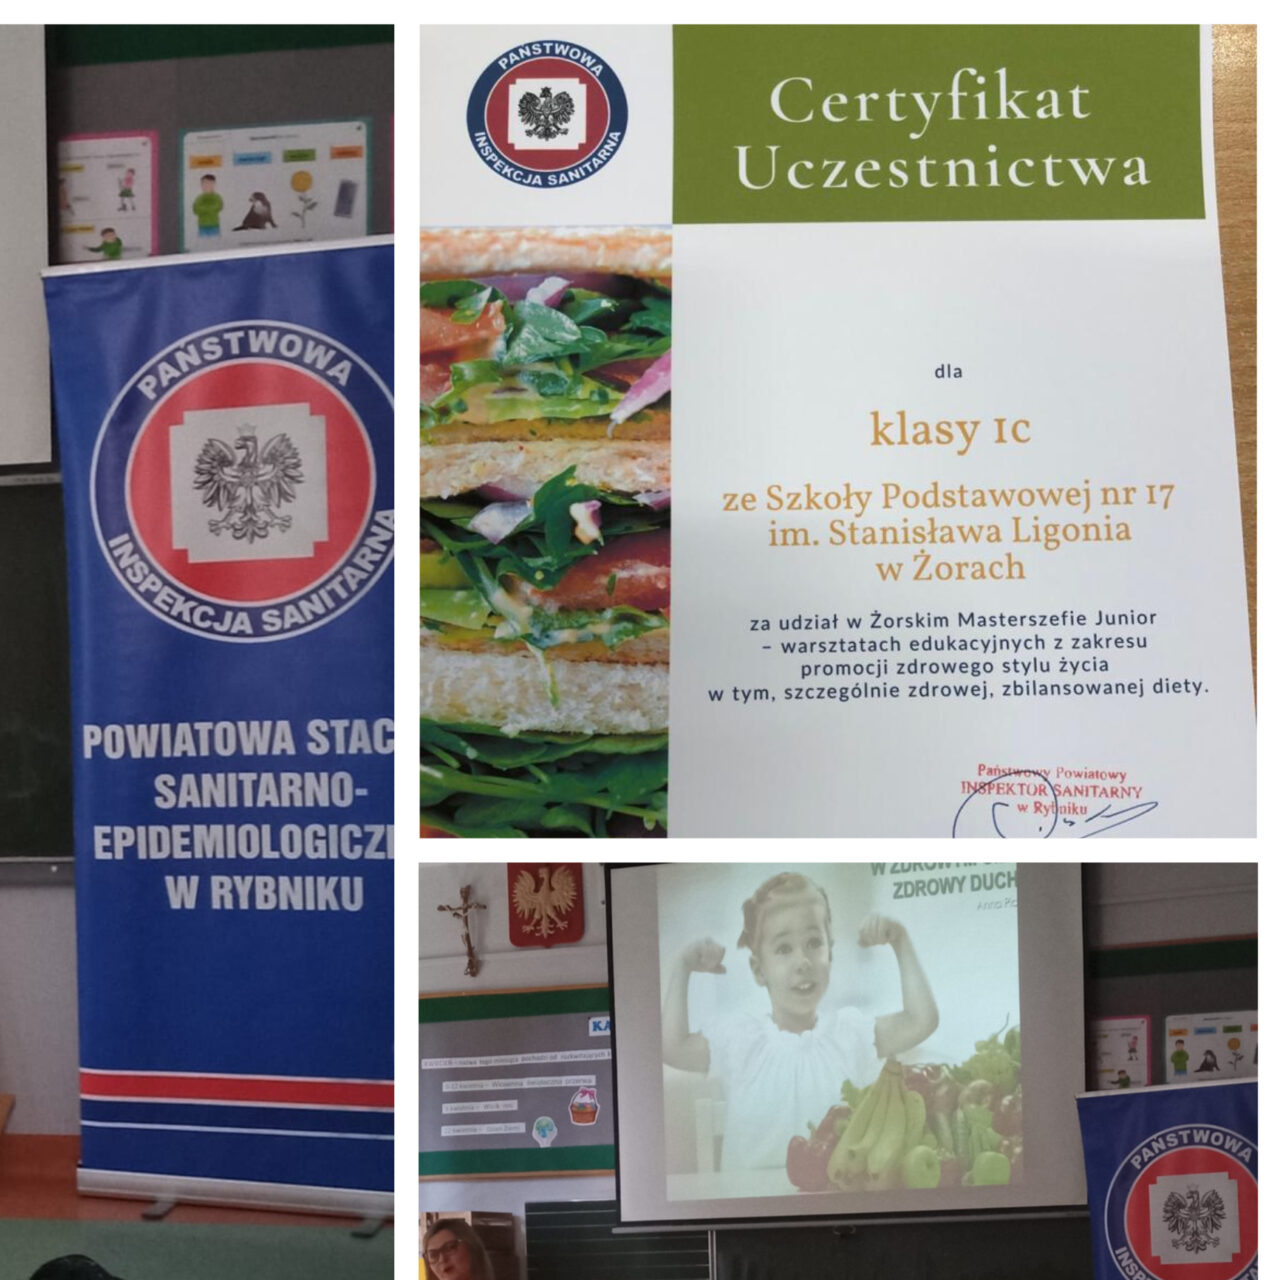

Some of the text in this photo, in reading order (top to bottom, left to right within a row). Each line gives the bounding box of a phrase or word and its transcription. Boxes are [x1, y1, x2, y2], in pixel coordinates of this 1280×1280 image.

[499, 42, 603, 77] PAŃSTWOWA
[771, 68, 1089, 139] Certyfikat
[475, 131, 621, 186] INSPEKCJA SANITARNA
[736, 145, 1150, 189] Uczestnictwa
[138, 330, 352, 400] PAŃSTWOWA
[935, 364, 962, 378] dla
[870, 410, 980, 456] klasy
[723, 493, 756, 511] ze
[767, 483, 872, 518] Szkoły
[882, 479, 1090, 514] Podstawowej
[1101, 487, 1136, 505] nr
[769, 515, 1131, 551] im. Stanisława Ligonia
[108, 509, 394, 634] INSPEKCJA SANITARNA
[876, 549, 1026, 581] w Żorach
[750, 610, 1156, 631] za udział w Żorskim Masterszefie Junior
[781, 636, 900, 653] warsztatach
[910, 634, 1045, 653] edukacyjnych
[1054, 638, 1063, 649] z
[1072, 633, 1146, 649] zakresu
[802, 656, 1108, 679] promocji zdrowego stylu życia
[708, 678, 1208, 704] w tym, szczególnie zdrowej, zbilansowanej diety.
[83, 718, 394, 759] POWIATOWA STAC
[154, 772, 368, 809] SANITARNO-
[961, 781, 1142, 799] INSPEKTOR SANITARNY
[977, 764, 1126, 783] Państwowy Powiatowy
[1017, 802, 1029, 812] w
[165, 875, 364, 911] W RYBNIKU
[893, 876, 967, 900] ZDROWY
[1131, 1129, 1253, 1170] PAŃSTWOWA
